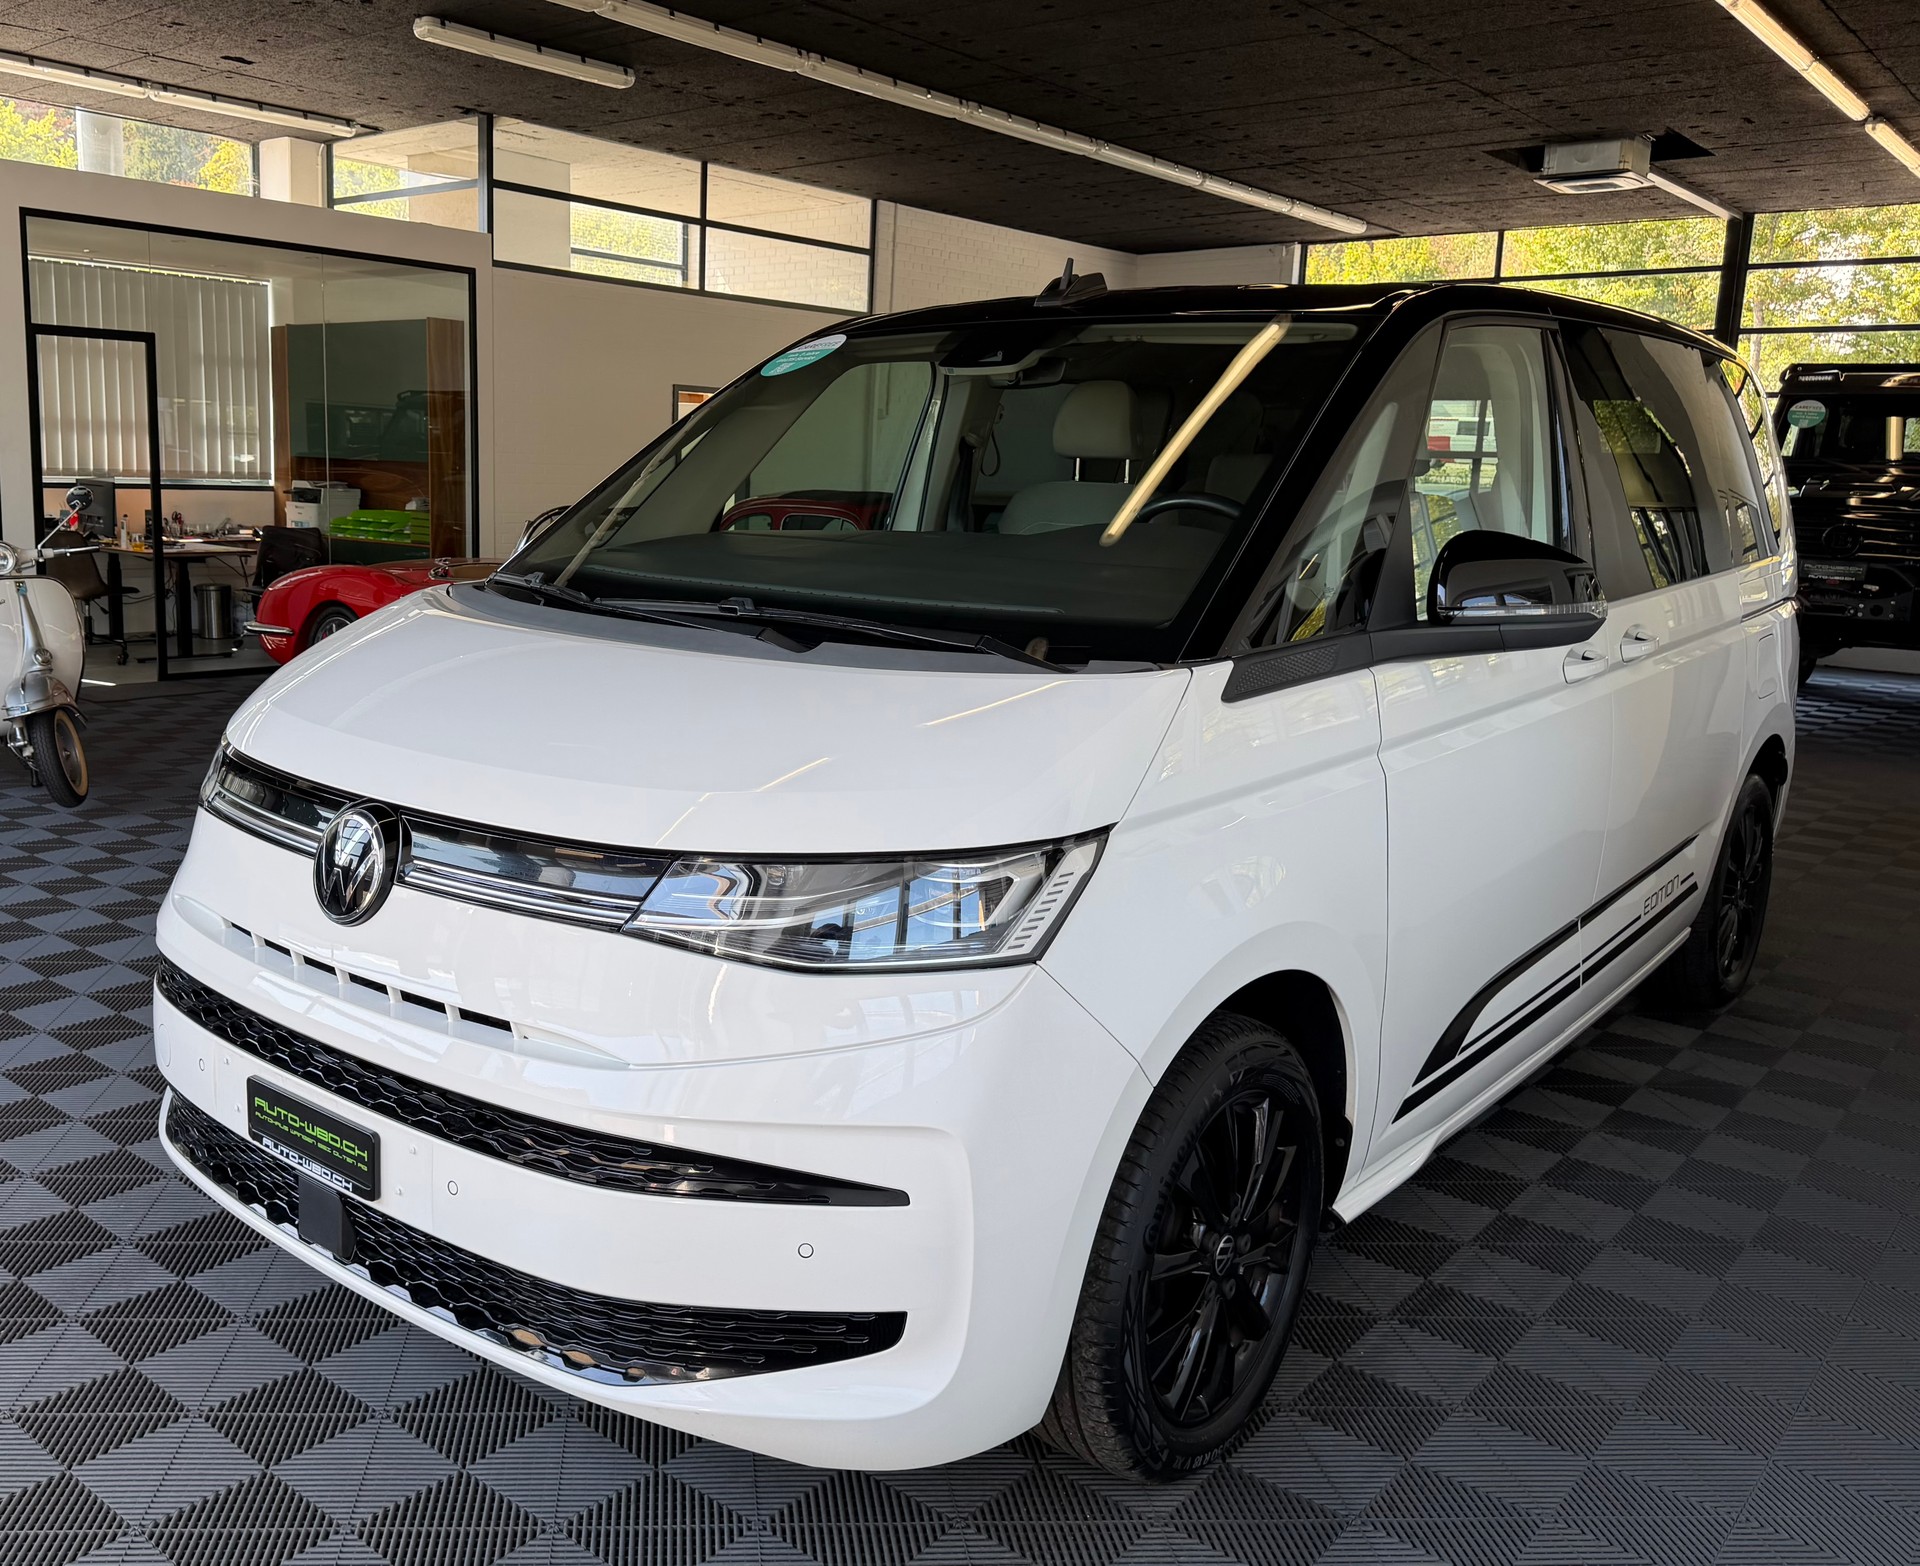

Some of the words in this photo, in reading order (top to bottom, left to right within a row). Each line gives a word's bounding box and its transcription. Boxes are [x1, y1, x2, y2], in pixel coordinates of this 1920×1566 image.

[1643, 874, 1680, 916] EDITION
[255, 1111, 289, 1132] AUTOHAUS
[289, 1128, 317, 1146] WANGEN
[333, 1150, 357, 1166] OLTEN
